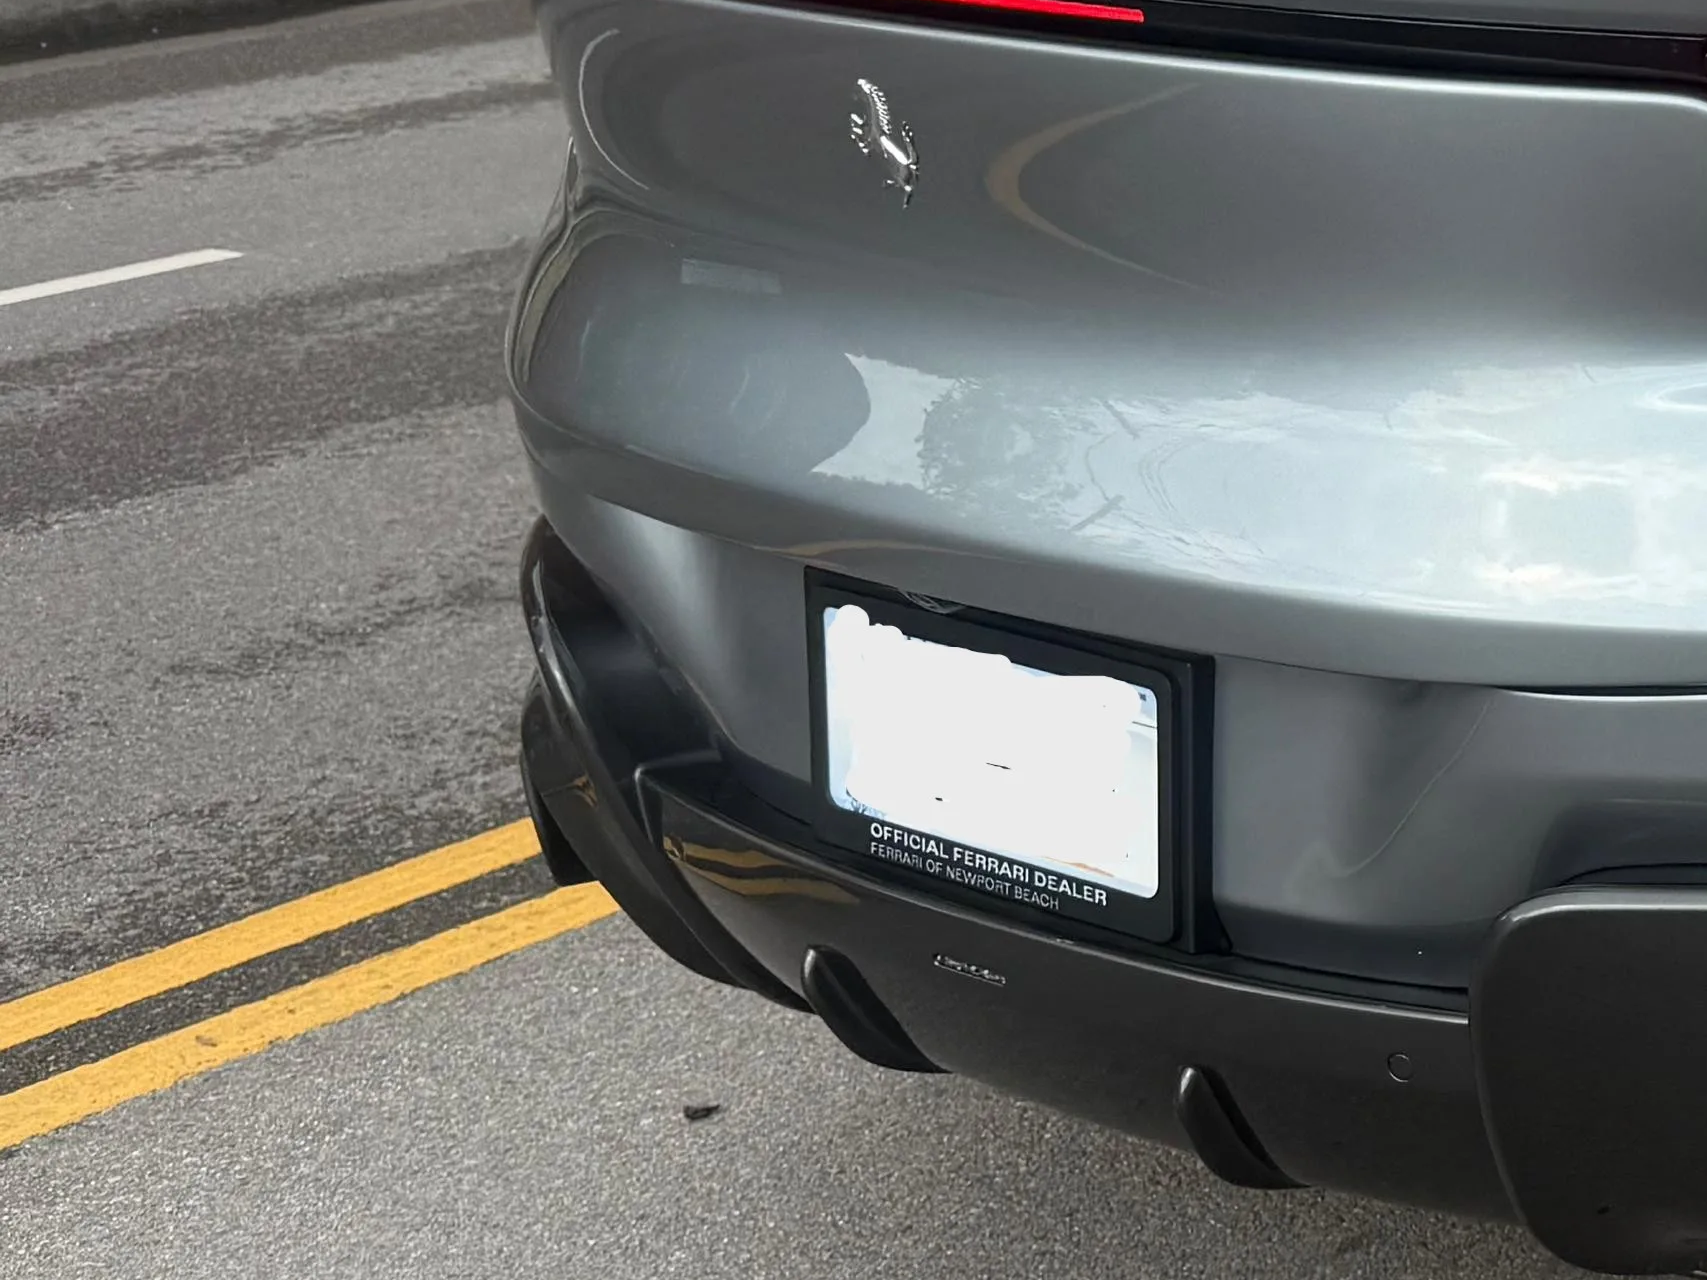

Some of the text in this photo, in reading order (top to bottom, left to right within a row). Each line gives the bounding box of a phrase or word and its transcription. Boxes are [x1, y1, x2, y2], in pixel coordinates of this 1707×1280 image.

[870, 822, 1108, 907] OFFICIAL FERRARI DEALER
[870, 841, 1060, 911] FERRARI OF NEWPORT BEACH
